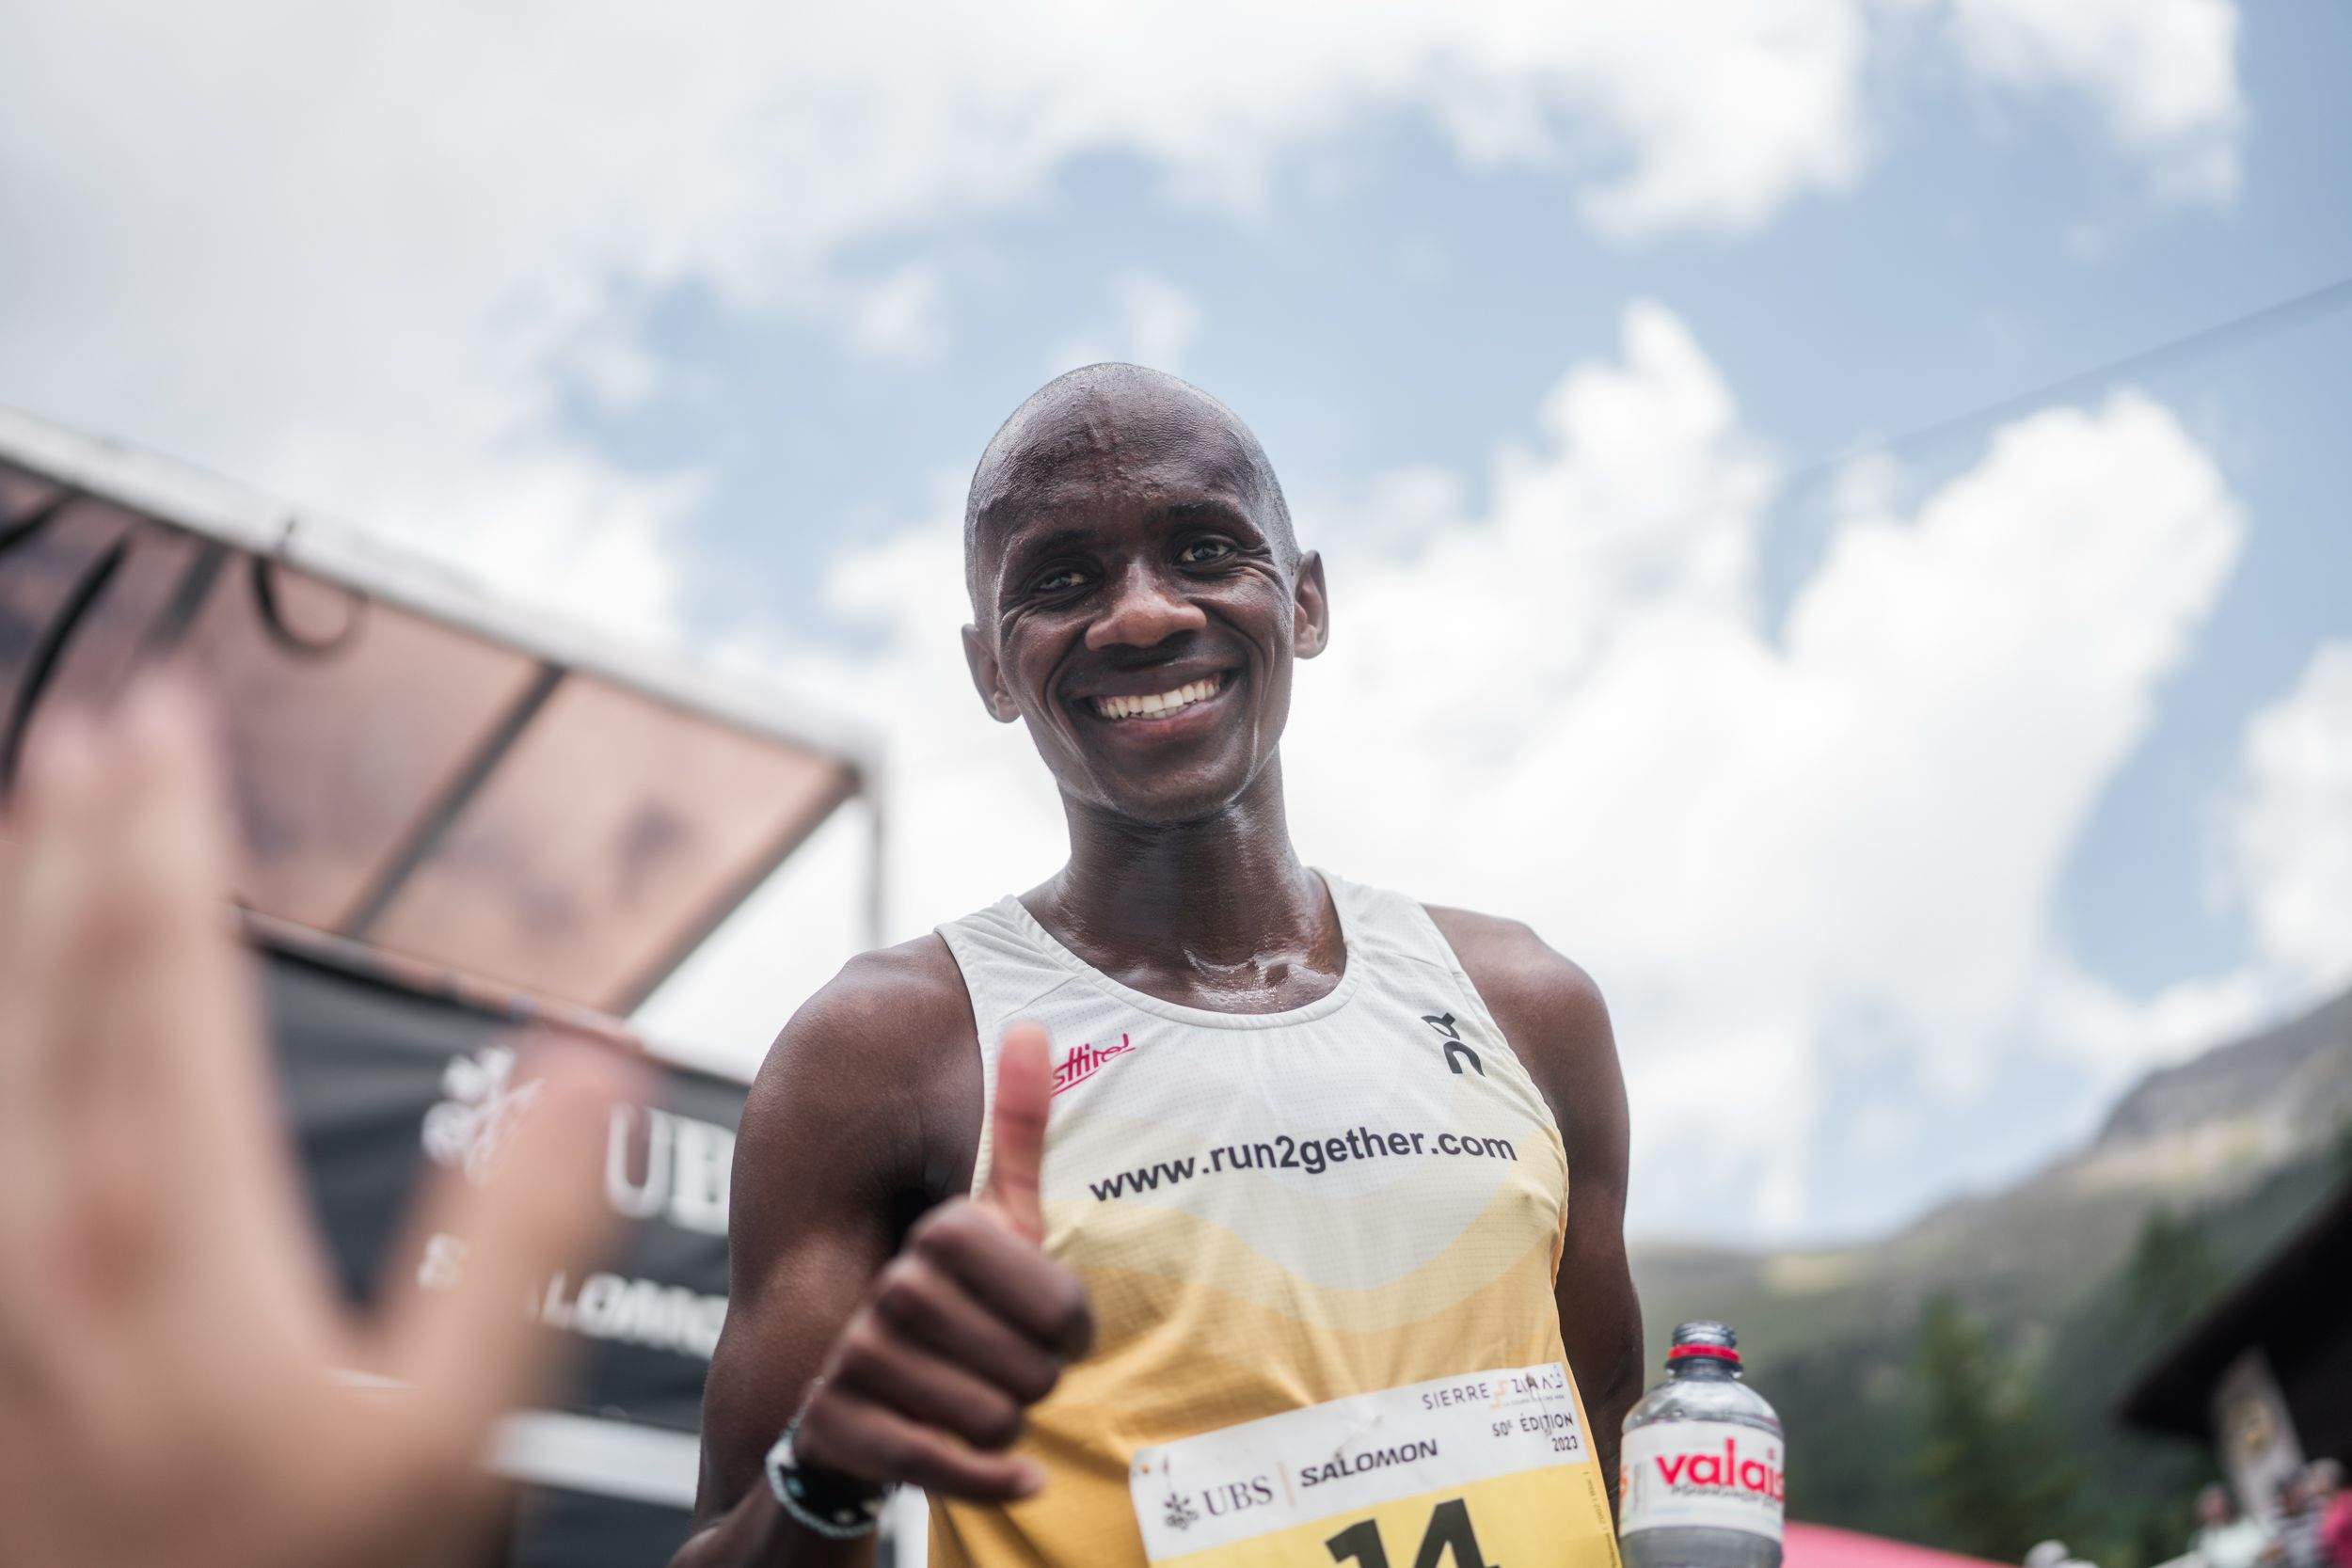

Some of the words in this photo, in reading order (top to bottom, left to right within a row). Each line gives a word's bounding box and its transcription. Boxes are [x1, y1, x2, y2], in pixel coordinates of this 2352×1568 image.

[605, 1101, 739, 1235] UB
[1089, 1127, 1518, 1201] www.run2gether.com
[1422, 1382, 1490, 1411] SIERRE
[1520, 1413, 1574, 1433] ÉDITION
[1552, 1435, 1579, 1452] 2023
[1300, 1439, 1438, 1487] SALOMON
[1202, 1475, 1274, 1516] UBS
[1326, 1498, 1500, 1568] 14
